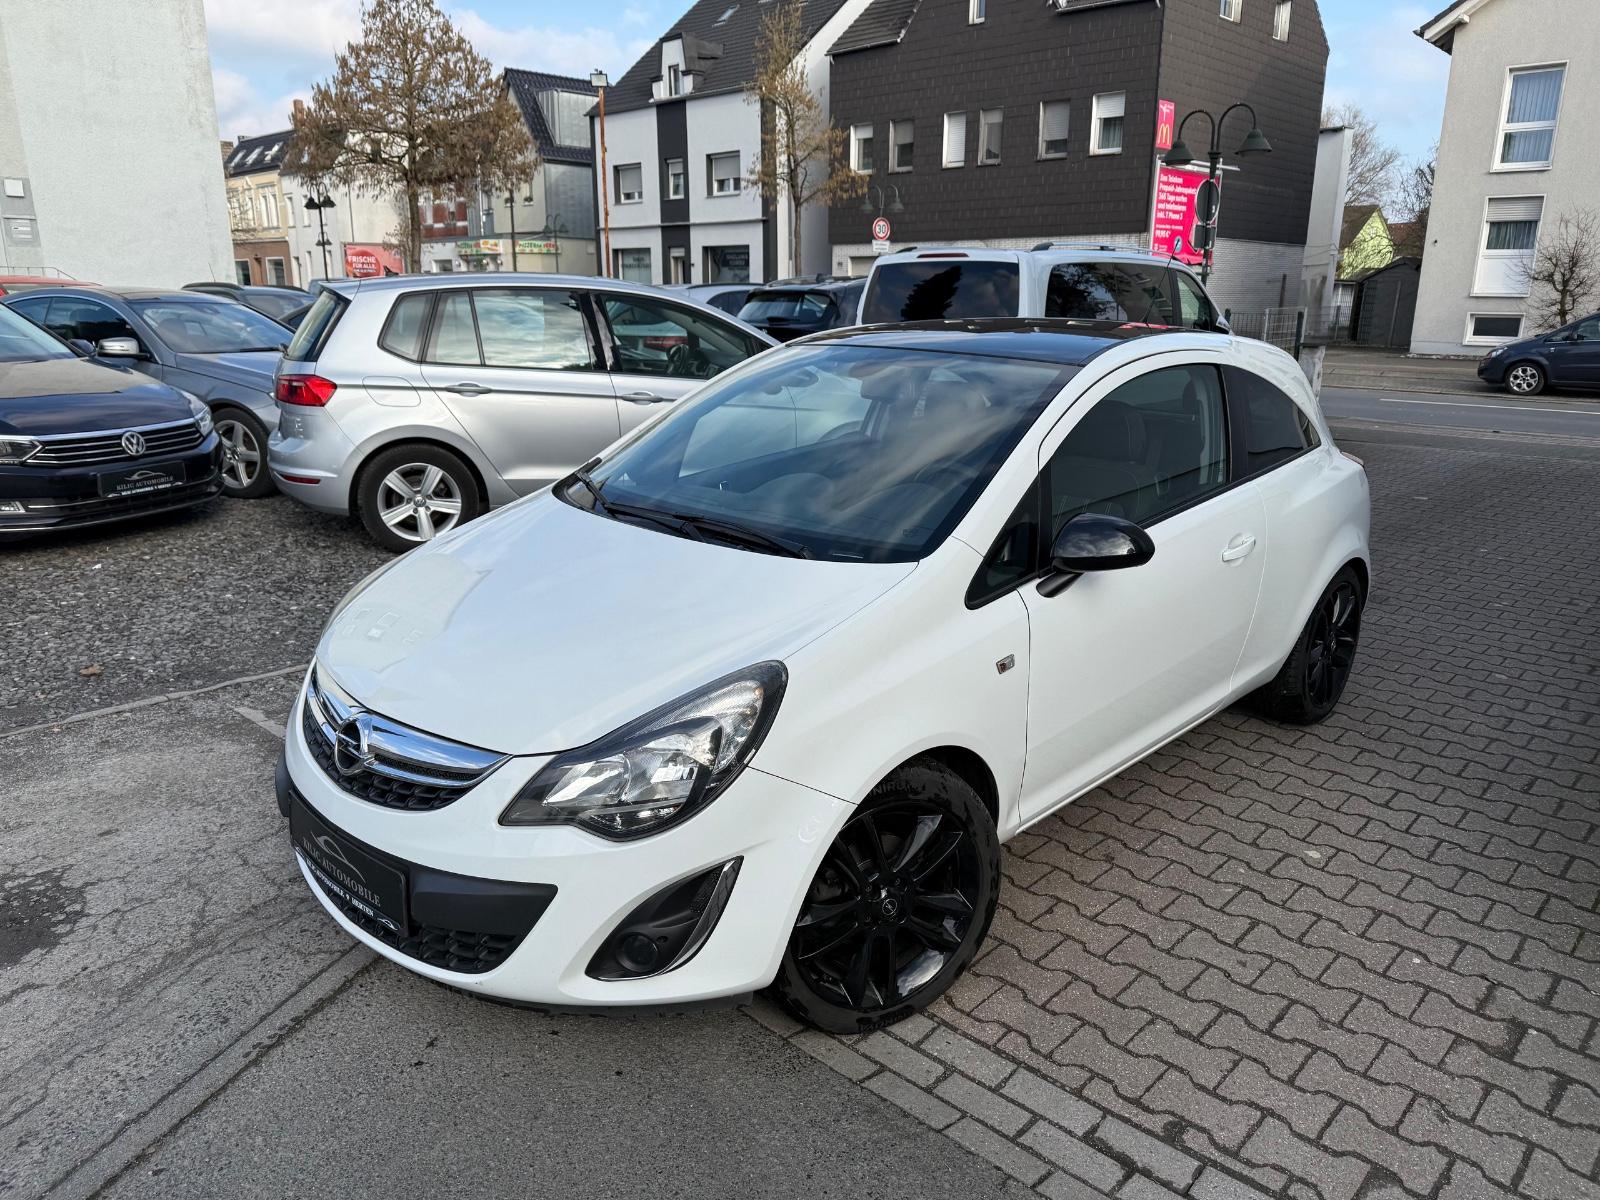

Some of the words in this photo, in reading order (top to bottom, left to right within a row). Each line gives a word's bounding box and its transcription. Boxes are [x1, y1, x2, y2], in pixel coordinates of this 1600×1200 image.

[877, 224, 887, 234] 30
[347, 255, 377, 263] FRISCHE
[322, 857, 381, 907] AUTOMOBILE
